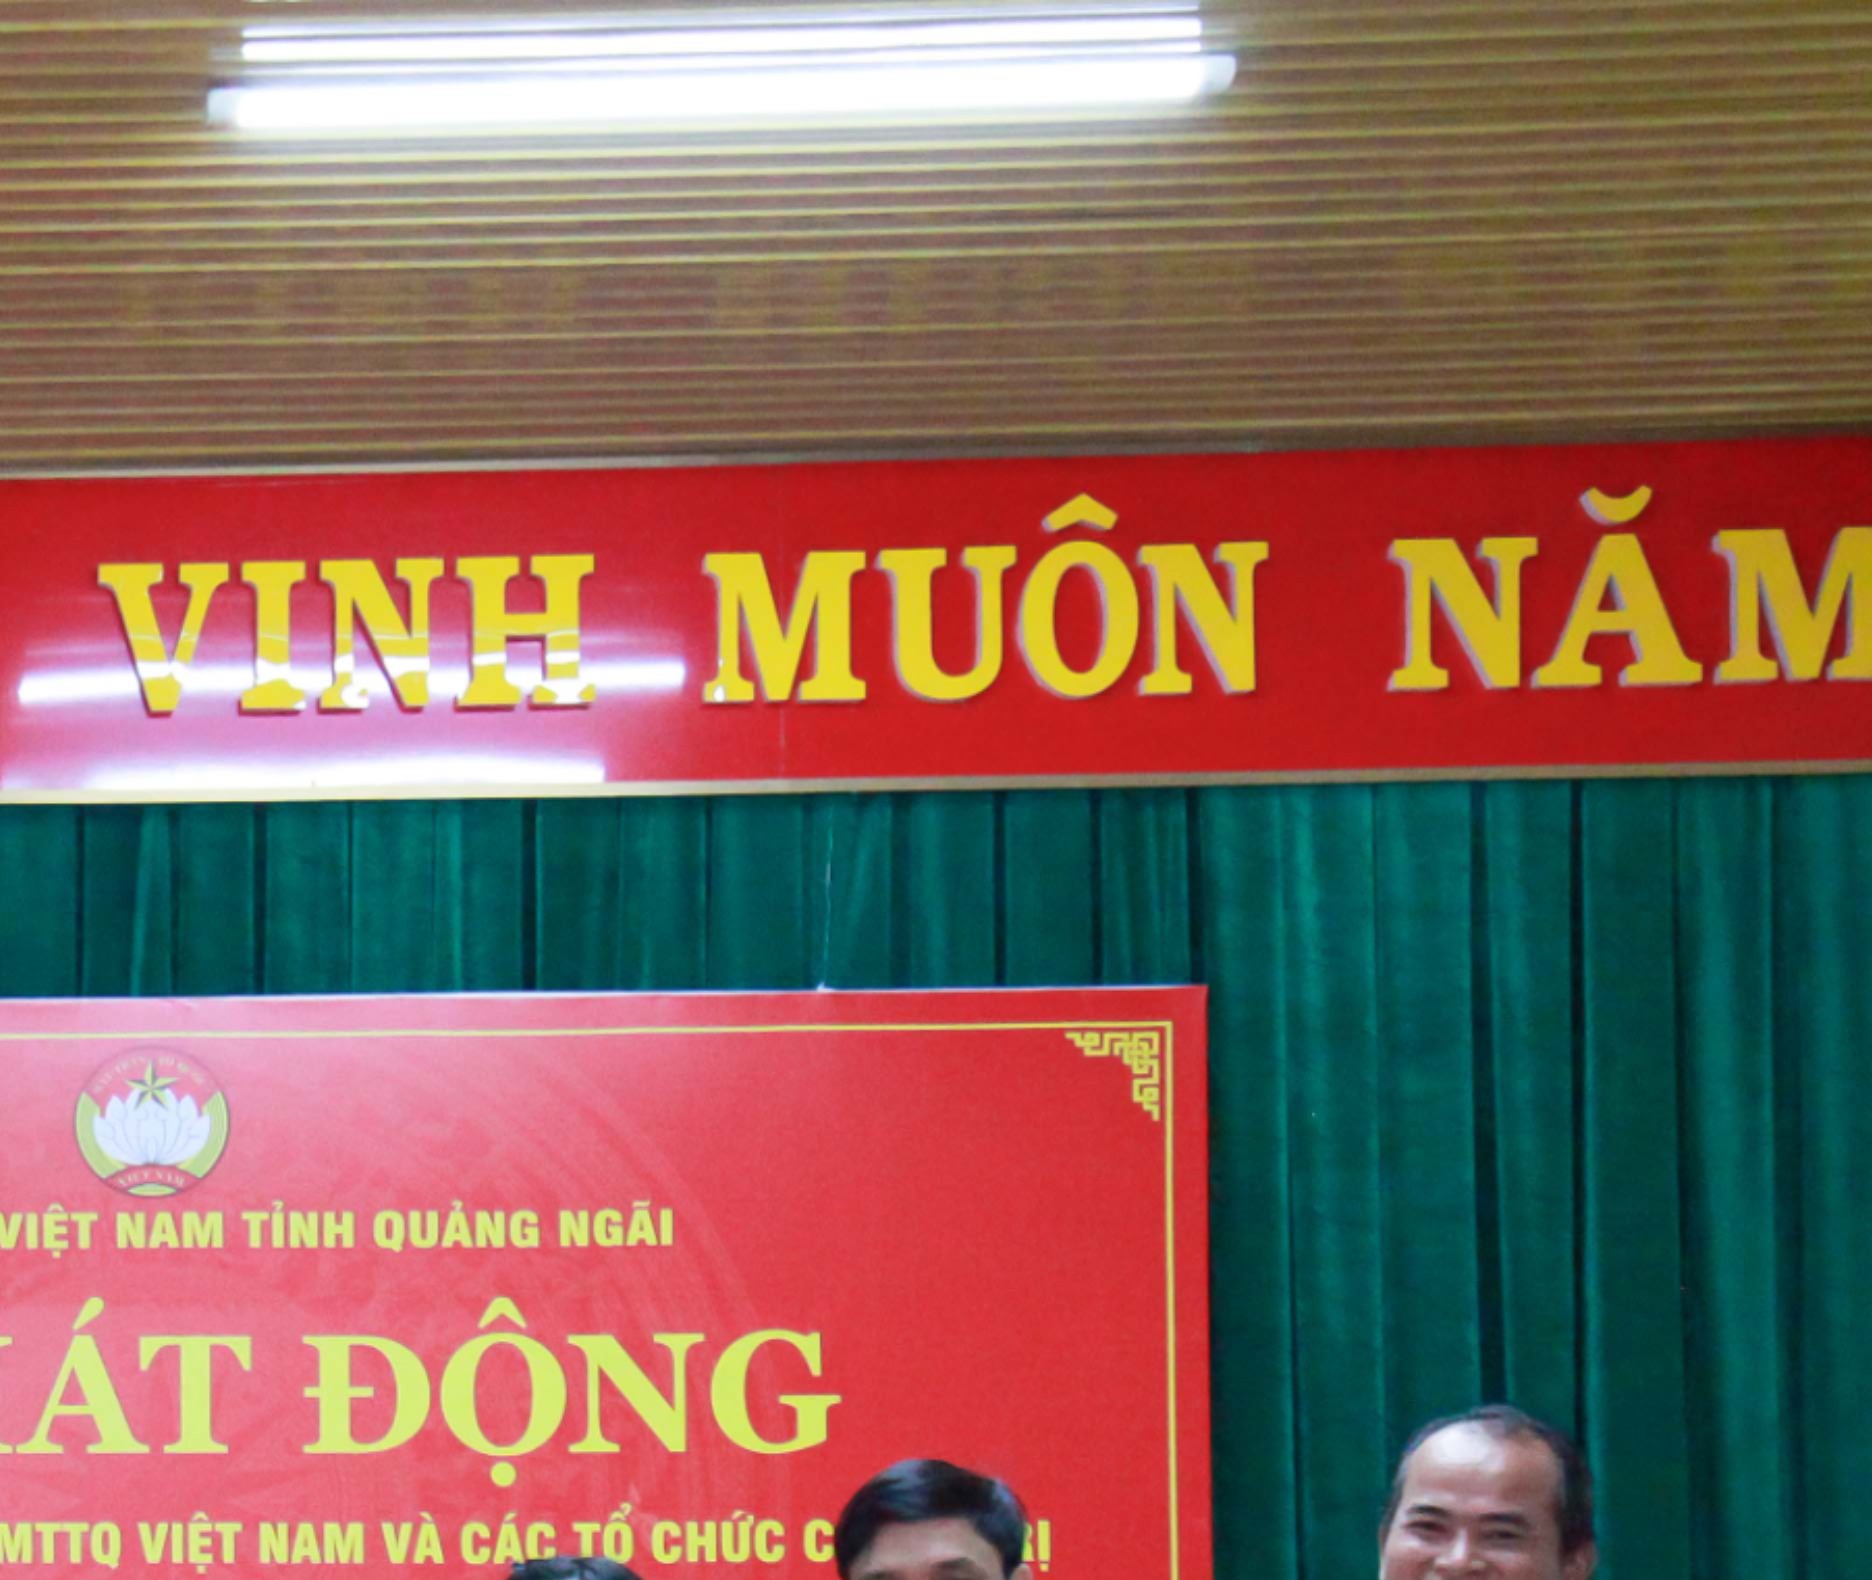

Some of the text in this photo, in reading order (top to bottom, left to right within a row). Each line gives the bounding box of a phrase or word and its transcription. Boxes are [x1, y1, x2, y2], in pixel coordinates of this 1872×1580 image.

[96, 553, 598, 713] VINH
[699, 493, 1269, 703] MUÔN
[1387, 485, 1872, 692] NĂM
[116, 1211, 225, 1249] NAM
[242, 1200, 355, 1249] TỈNH
[373, 1199, 541, 1252] QUẢNG
[559, 1201, 674, 1247] NGÃI
[302, 1295, 843, 1489] ĐỘNG
[138, 1512, 243, 1574] VIỆT
[259, 1521, 366, 1564] NAM
[382, 1512, 445, 1565] VÀ
[460, 1511, 557, 1565] CÁC
[573, 1502, 635, 1564] TỔ
[651, 1510, 786, 1564] CHỨC
